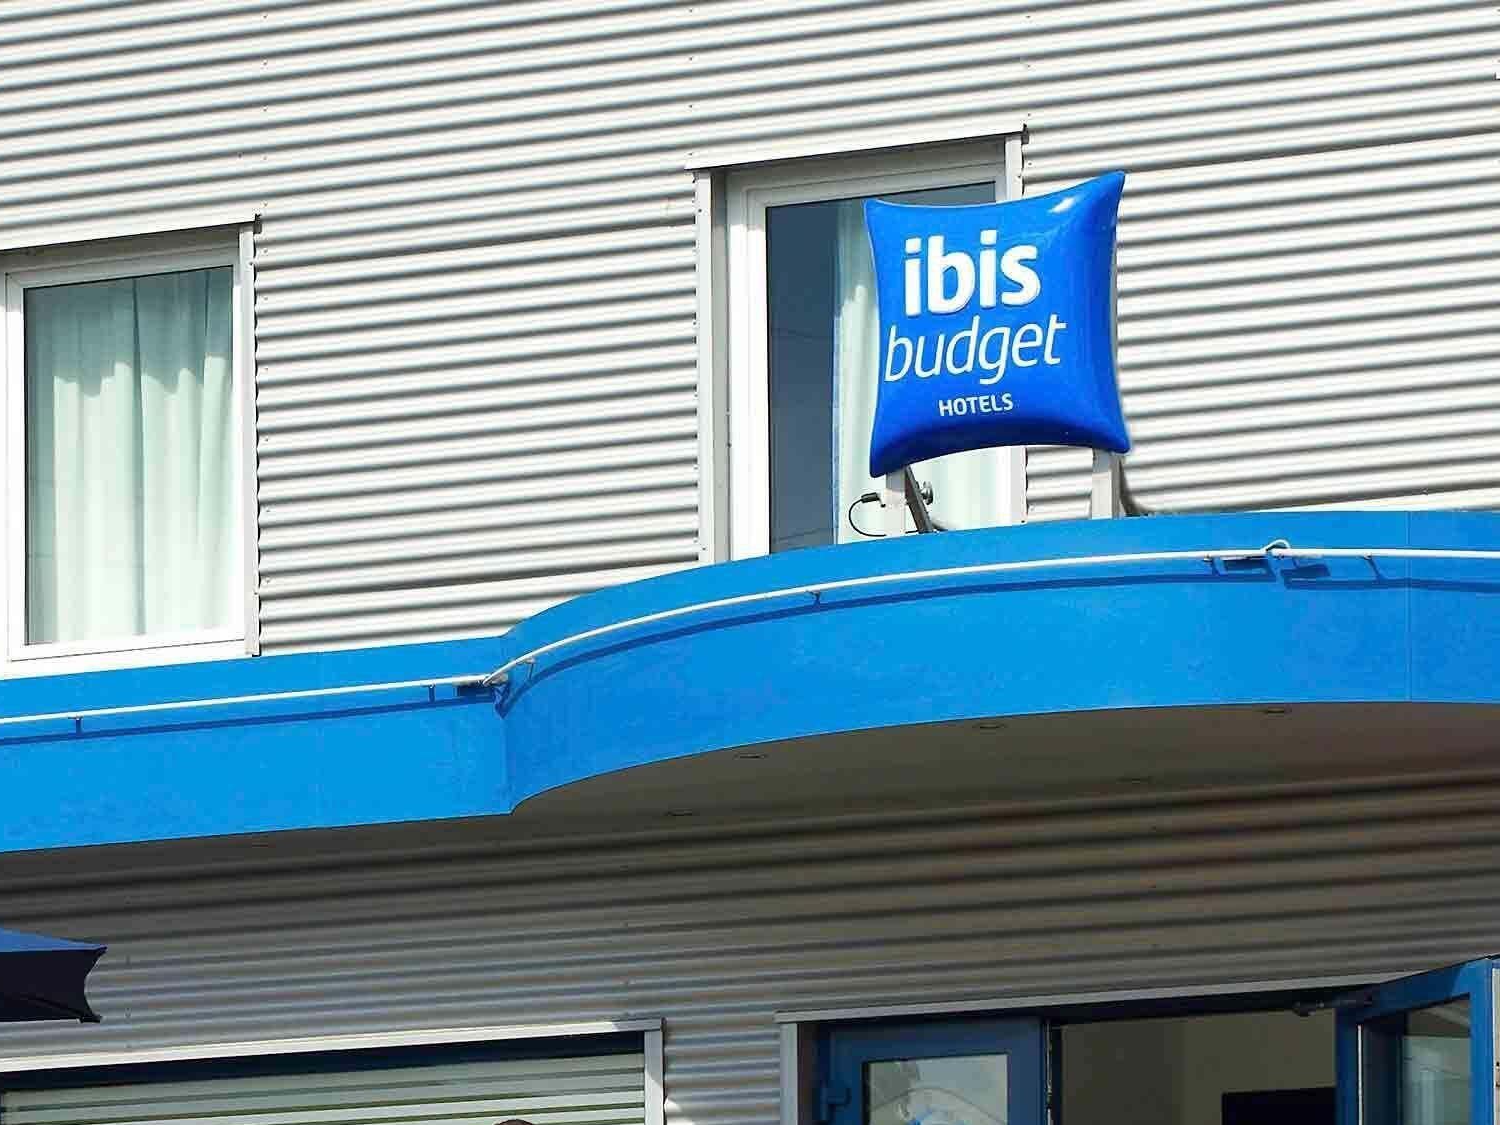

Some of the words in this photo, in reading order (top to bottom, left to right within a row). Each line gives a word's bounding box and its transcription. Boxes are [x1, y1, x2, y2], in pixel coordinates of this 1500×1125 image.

[904, 229, 1042, 317] ibis
[884, 314, 1067, 386] budget
[938, 393, 1014, 417] HOTELS
